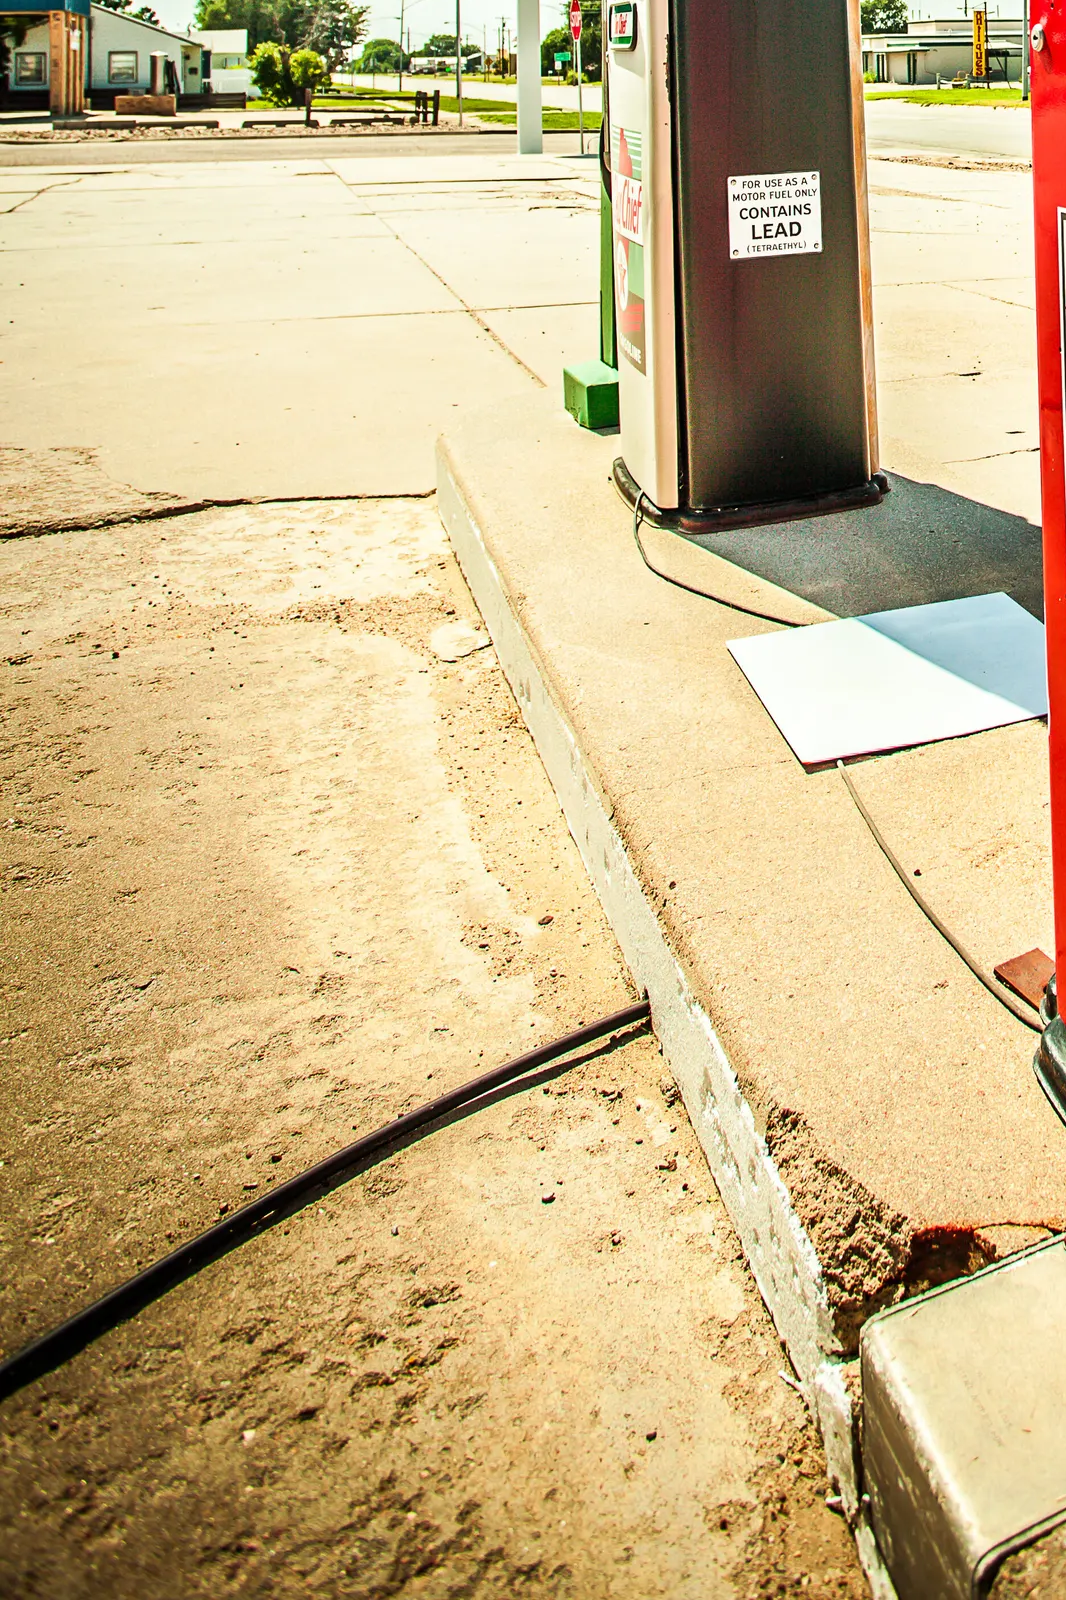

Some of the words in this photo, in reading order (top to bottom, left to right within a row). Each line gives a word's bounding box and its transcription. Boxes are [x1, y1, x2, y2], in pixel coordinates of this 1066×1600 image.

[742, 180, 761, 189] FOR
[764, 179, 783, 188] USE
[785, 177, 798, 187] AS
[801, 177, 808, 185] A
[732, 192, 766, 202] MOTOR
[769, 190, 793, 200] FUEL
[795, 188, 818, 198] ONLY
[622, 179, 643, 235] Chief
[739, 203, 812, 220] CONTAINS
[751, 221, 802, 240] LEAD
[746, 240, 807, 254] (TETRAETHYL)
